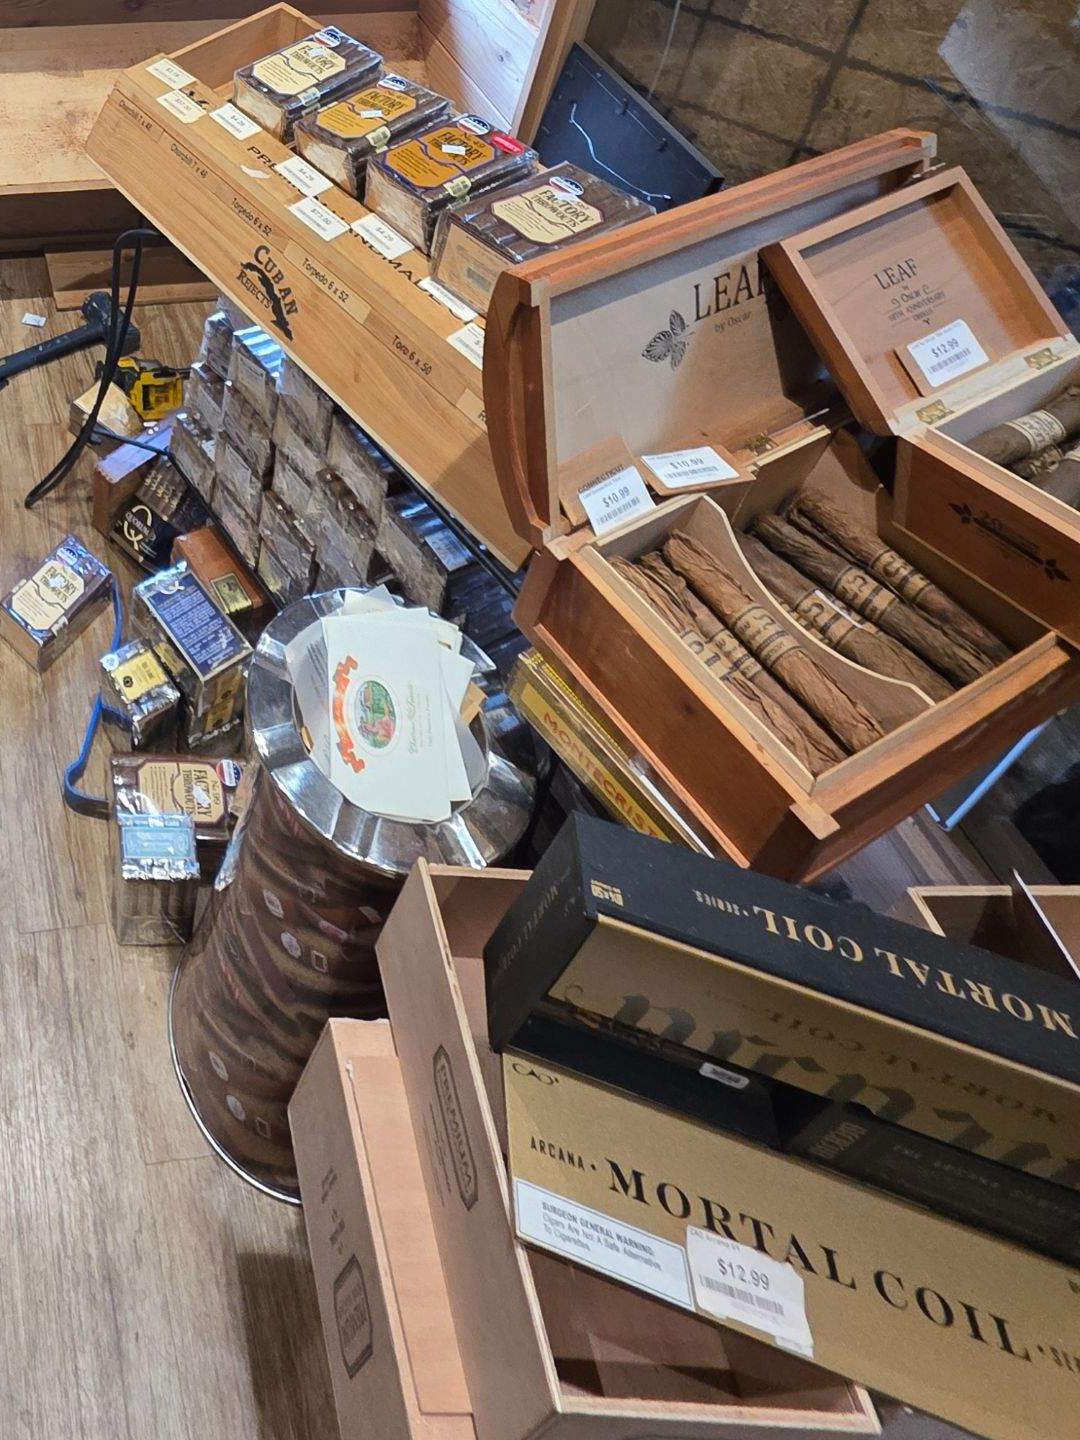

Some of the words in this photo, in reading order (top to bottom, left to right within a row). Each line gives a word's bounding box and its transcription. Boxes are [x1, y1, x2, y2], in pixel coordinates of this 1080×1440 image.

[231, 197, 255, 222] Torpedo
[236, 268, 272, 310] REJECTS
[253, 244, 299, 316] CUBAN
[302, 257, 329, 288] Torpedo
[338, 290, 350, 303] 52
[873, 257, 919, 291] LEAF
[391, 334, 410, 358] Toro
[931, 338, 960, 359] $12.99
[669, 457, 705, 471] $10.99
[602, 486, 631, 509] $10.99
[542, 711, 657, 837] MONTECRIST
[752, 904, 864, 962] COIL
[874, 947, 1080, 1040] MORTAL
[530, 1135, 586, 1171] ARCANA
[605, 1157, 857, 1290] MORTAL
[873, 1269, 1033, 1364] COIL
[716, 1258, 770, 1292] $12.99
